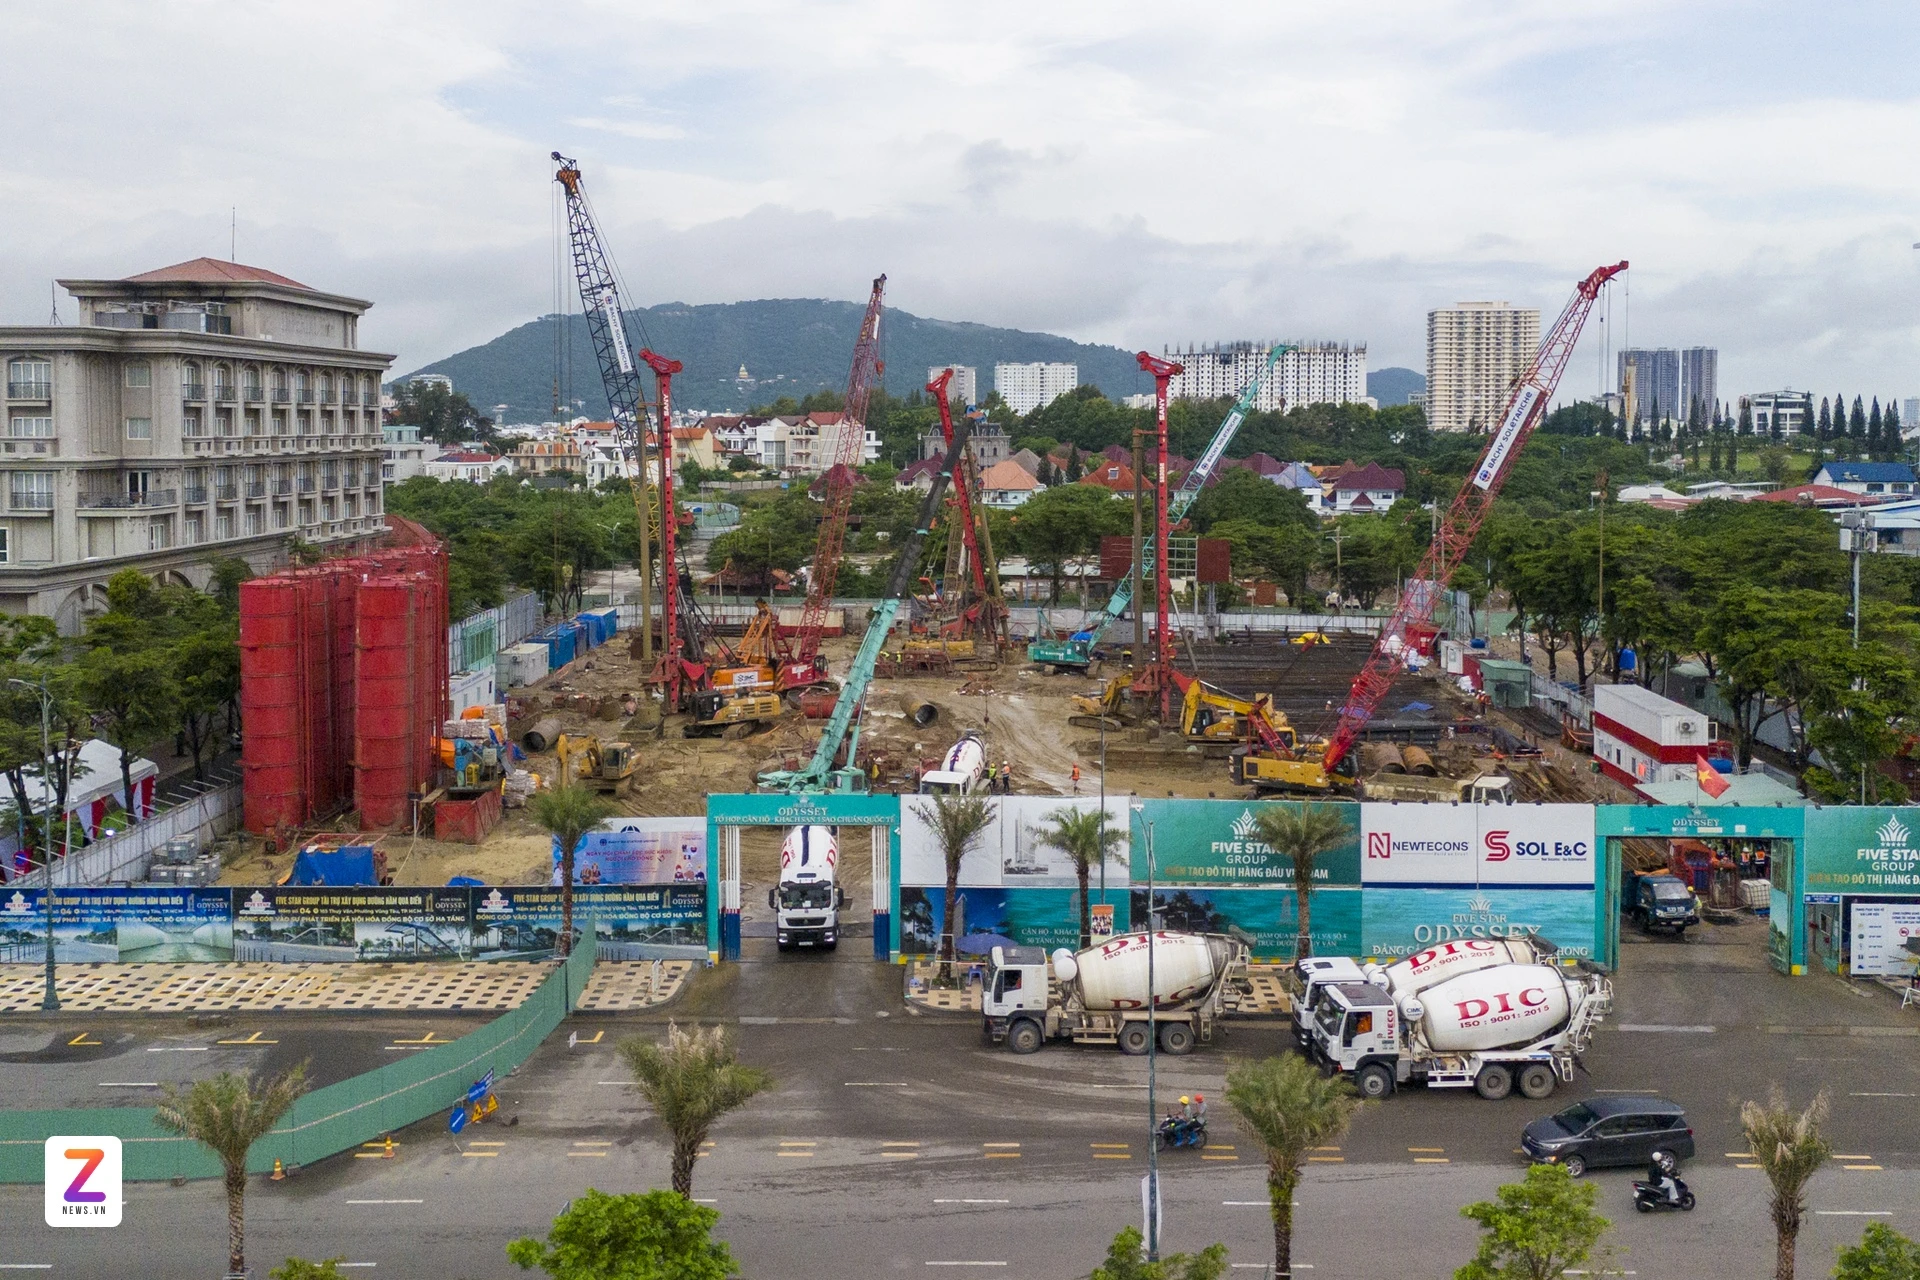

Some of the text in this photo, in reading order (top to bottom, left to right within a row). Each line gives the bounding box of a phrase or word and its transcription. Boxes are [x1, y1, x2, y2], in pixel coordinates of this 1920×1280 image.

[1488, 443, 1505, 469] BACHY
[778, 807, 828, 816] ODYSSEY
[1673, 818, 1719, 827] ODYSSEY
[1211, 842, 1242, 854] FIVE
[1392, 841, 1468, 851] NEWTECONS
[1516, 842, 1587, 856] SOL E&C
[1226, 855, 1267, 864] GROUP
[1857, 849, 1889, 860] FIVE
[1871, 861, 1915, 871] GROUP
[1221, 867, 1236, 879] THỊ
[1238, 866, 1263, 877] HÀNG
[1867, 874, 1882, 886] THỊ
[1884, 872, 1911, 884] HÀNG
[1453, 914, 1506, 923] FIVE STAR
[1104, 951, 1121, 961] ISO
[1410, 939, 1494, 970] DIC
[1413, 965, 1431, 975] ISO
[1453, 987, 1547, 1021] DIC
[1460, 1020, 1480, 1028] ISO
[1524, 1005, 1549, 1016] 2015
